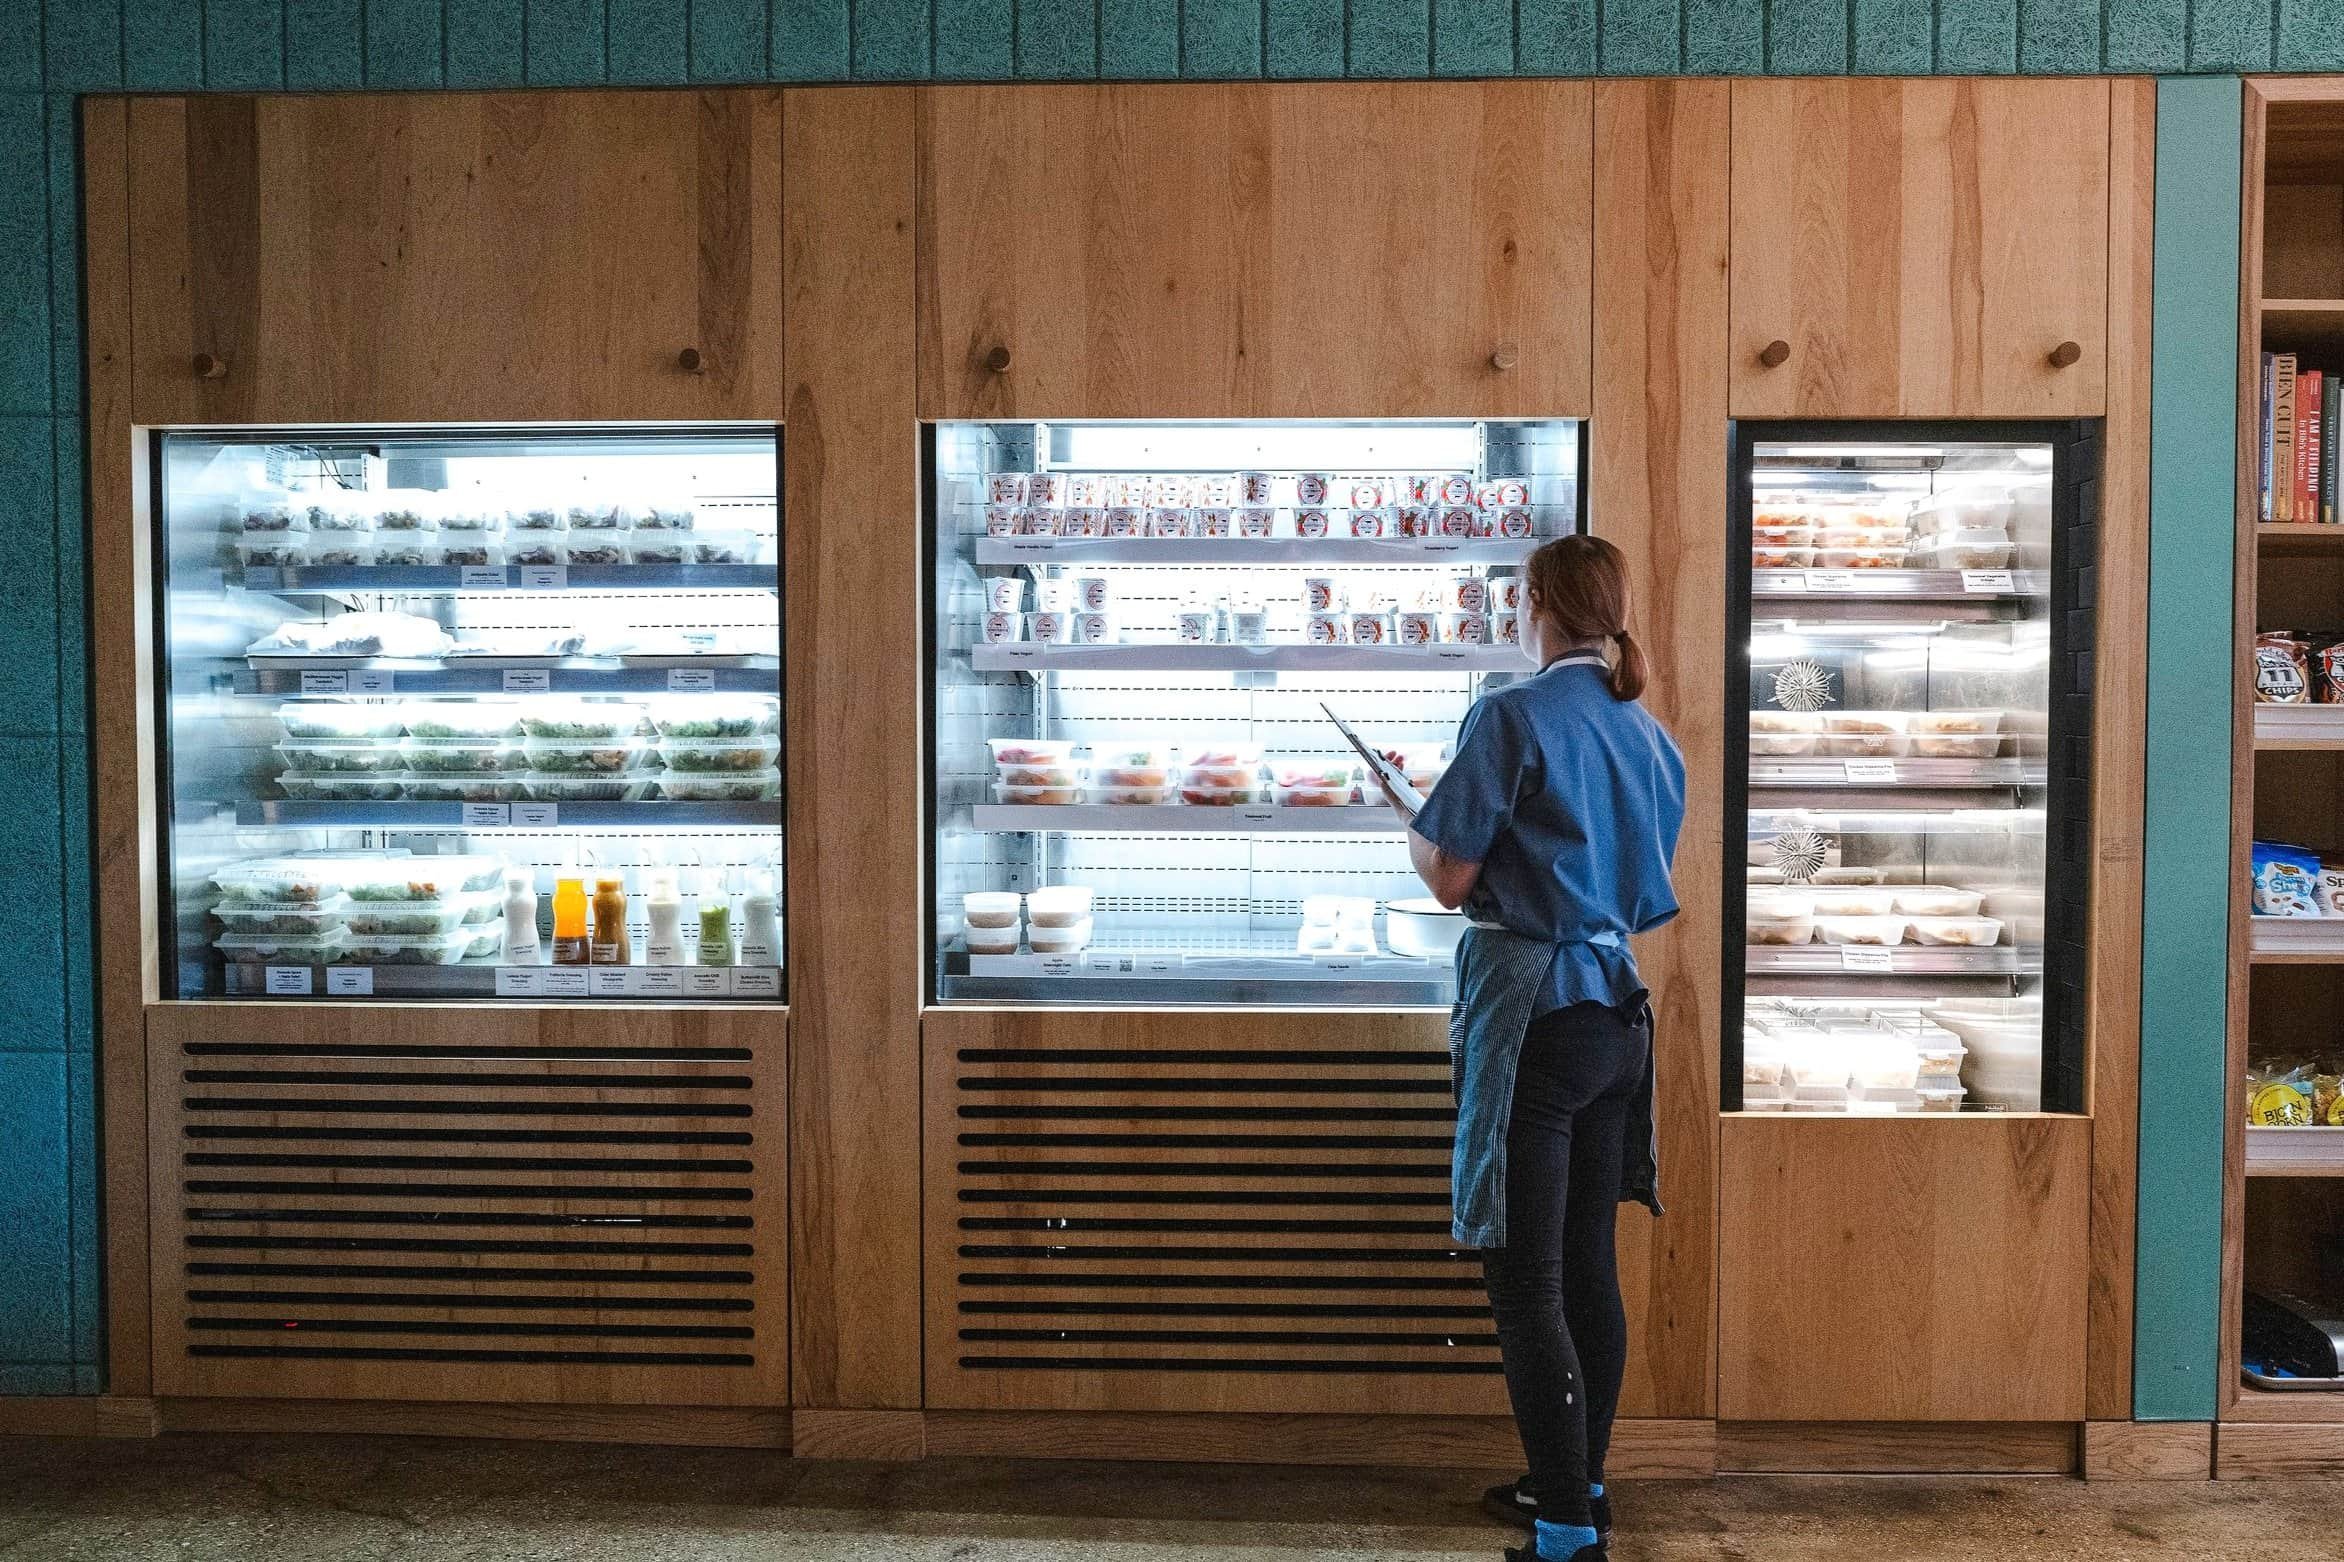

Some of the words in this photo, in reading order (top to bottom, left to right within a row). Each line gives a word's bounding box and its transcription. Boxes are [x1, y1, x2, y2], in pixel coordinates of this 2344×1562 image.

[2278, 359, 2293, 399] BIEN
[2277, 405, 2292, 447] CUIT
[2309, 418, 2320, 434] AM
[2297, 451, 2306, 480] Kitchen
[2264, 669, 2295, 682] 11
[2265, 687, 2300, 695] CHIPS
